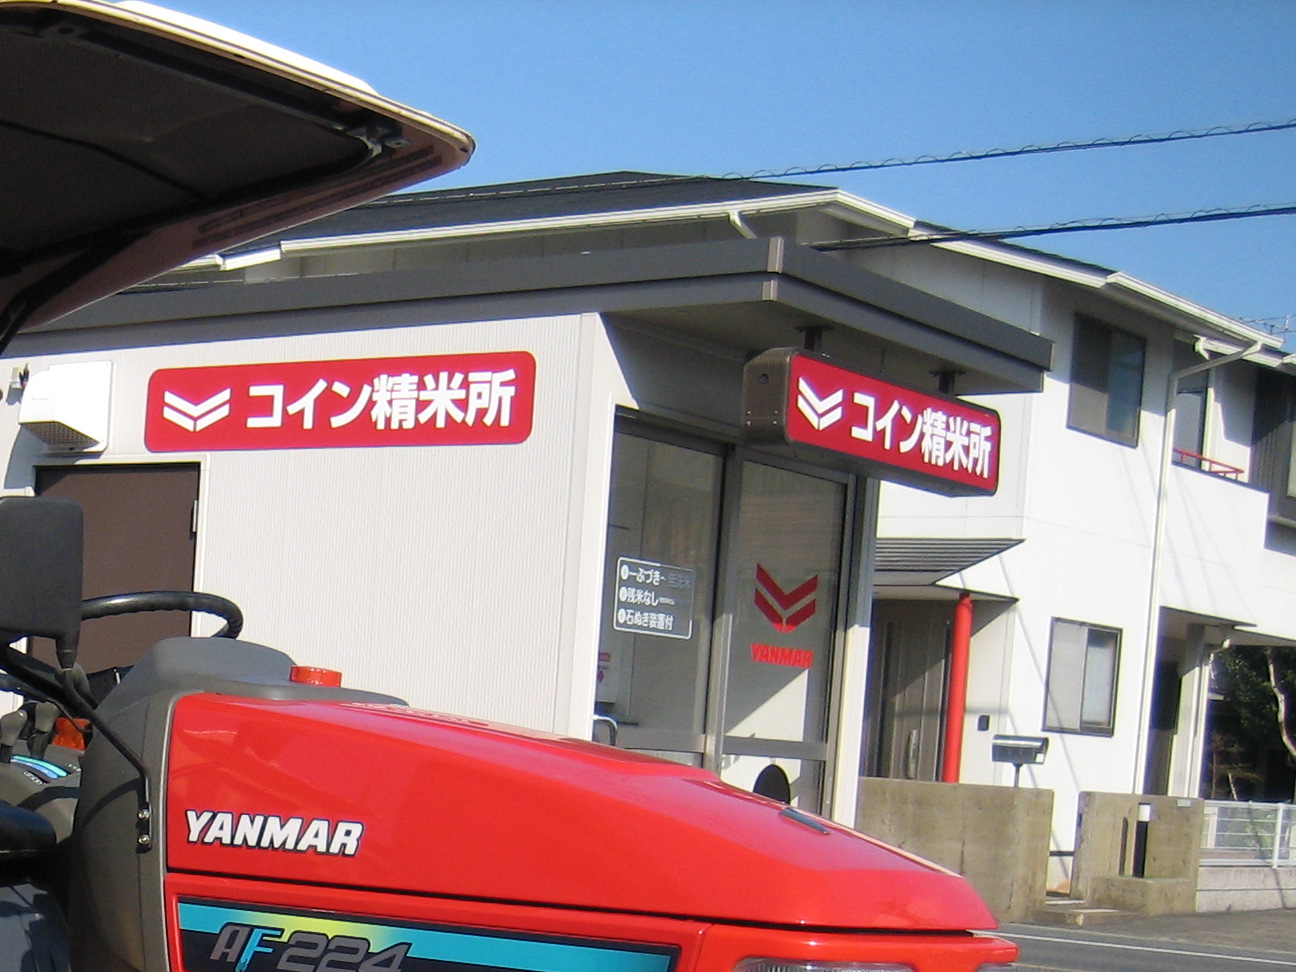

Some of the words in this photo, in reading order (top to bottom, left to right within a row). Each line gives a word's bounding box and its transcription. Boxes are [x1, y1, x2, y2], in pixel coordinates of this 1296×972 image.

[245, 368, 518, 431] コイン精米所
[850, 391, 993, 480] コイン精米所
[751, 642, 814, 669] YANMAR
[185, 810, 364, 856] YANMAR
